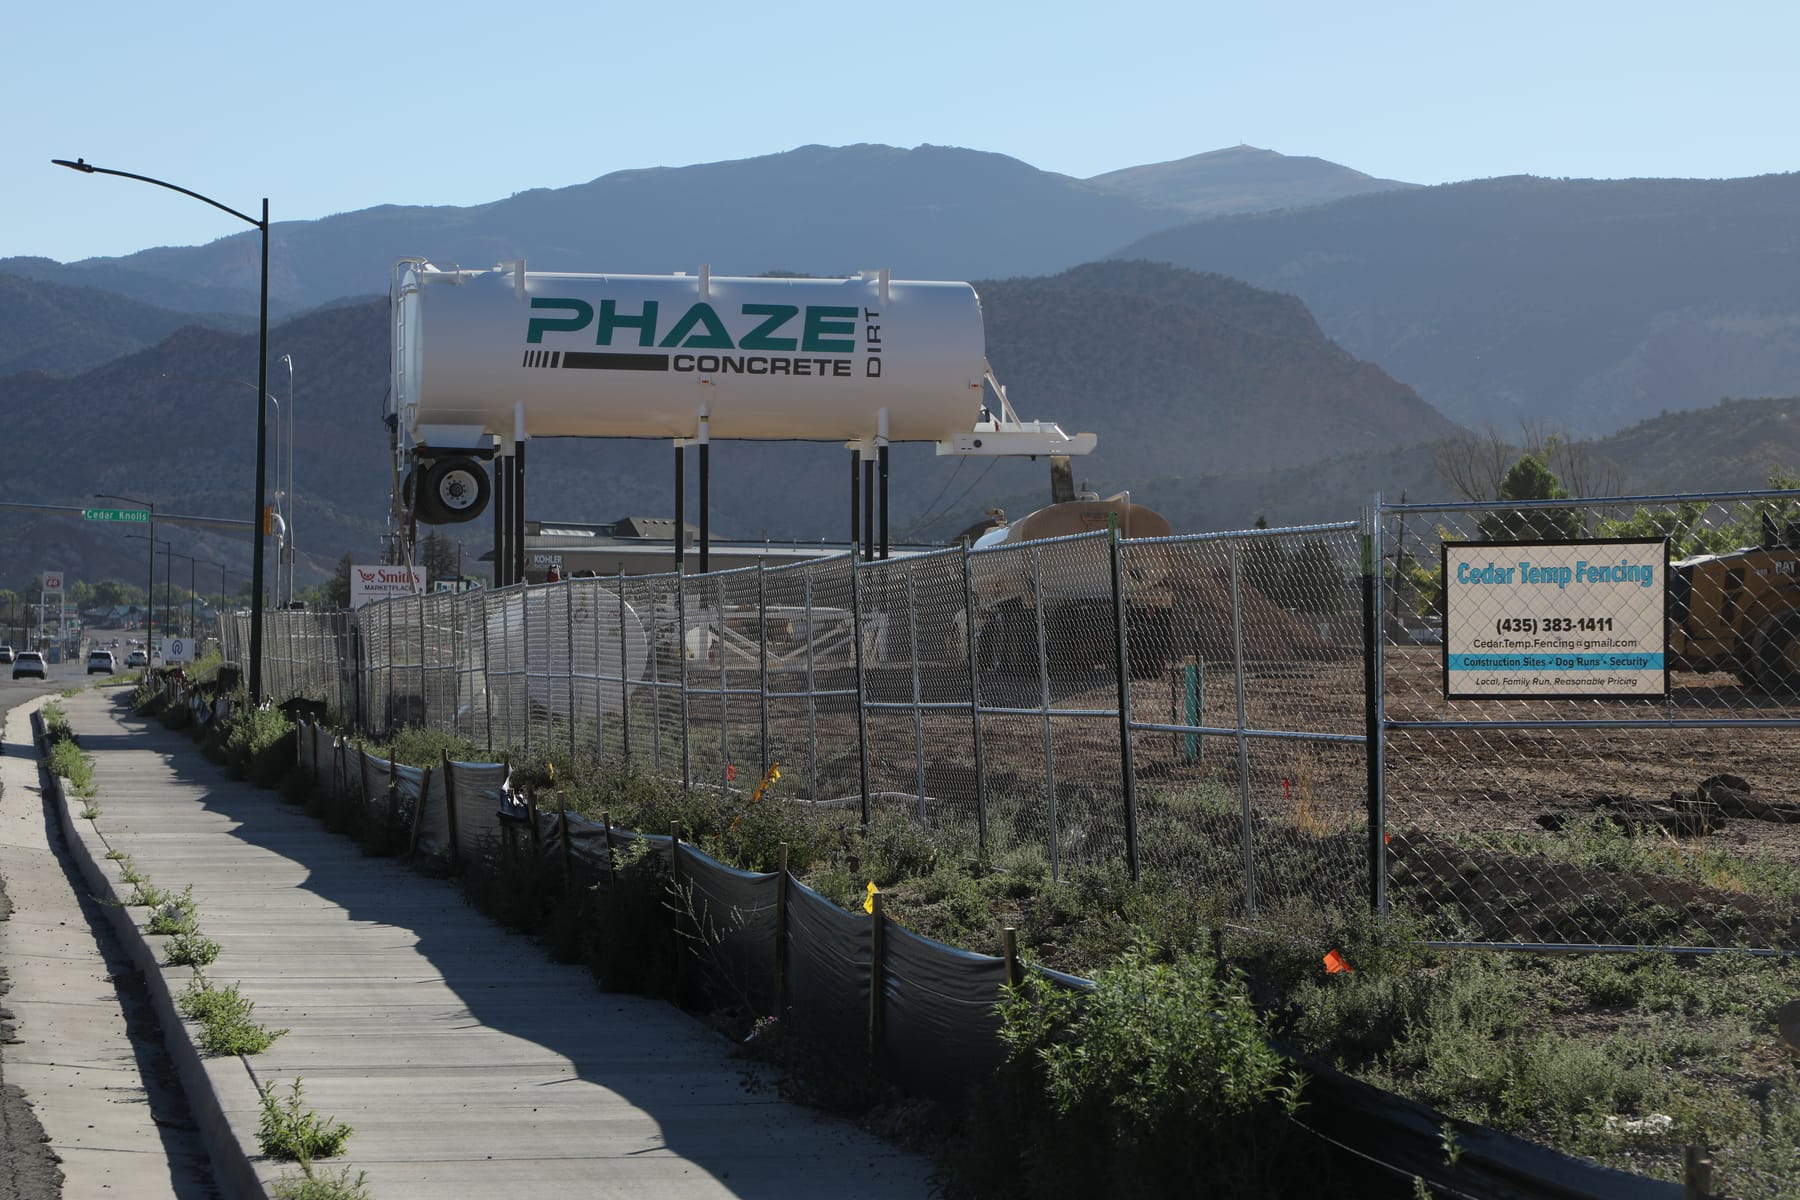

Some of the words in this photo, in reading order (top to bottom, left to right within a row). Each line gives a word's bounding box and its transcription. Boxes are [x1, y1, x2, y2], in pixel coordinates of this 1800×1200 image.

[526, 298, 859, 353] PHAZE
[865, 307, 881, 378] DIRT
[673, 354, 852, 377] CONCRETE
[87, 510, 113, 519] Cedar
[119, 511, 147, 520] Knolls
[534, 555, 562, 564] KOHLER
[1457, 562, 1515, 585] Cedar
[1518, 561, 1571, 589] Temp
[1576, 559, 1654, 588] Fencing
[1496, 618, 1538, 635] (435)
[1542, 617, 1613, 632] 383-1411
[1463, 657, 1521, 667] Construction
[1523, 657, 1546, 667] Sites
[1555, 657, 1574, 668] Dog
[1577, 657, 1600, 666] Runs
[1609, 656, 1648, 667] Security
[1476, 678, 1500, 686] Local,
[1502, 677, 1530, 687] Family
[1554, 677, 1605, 686] Reasonable
[1607, 677, 1637, 687] Pricing
